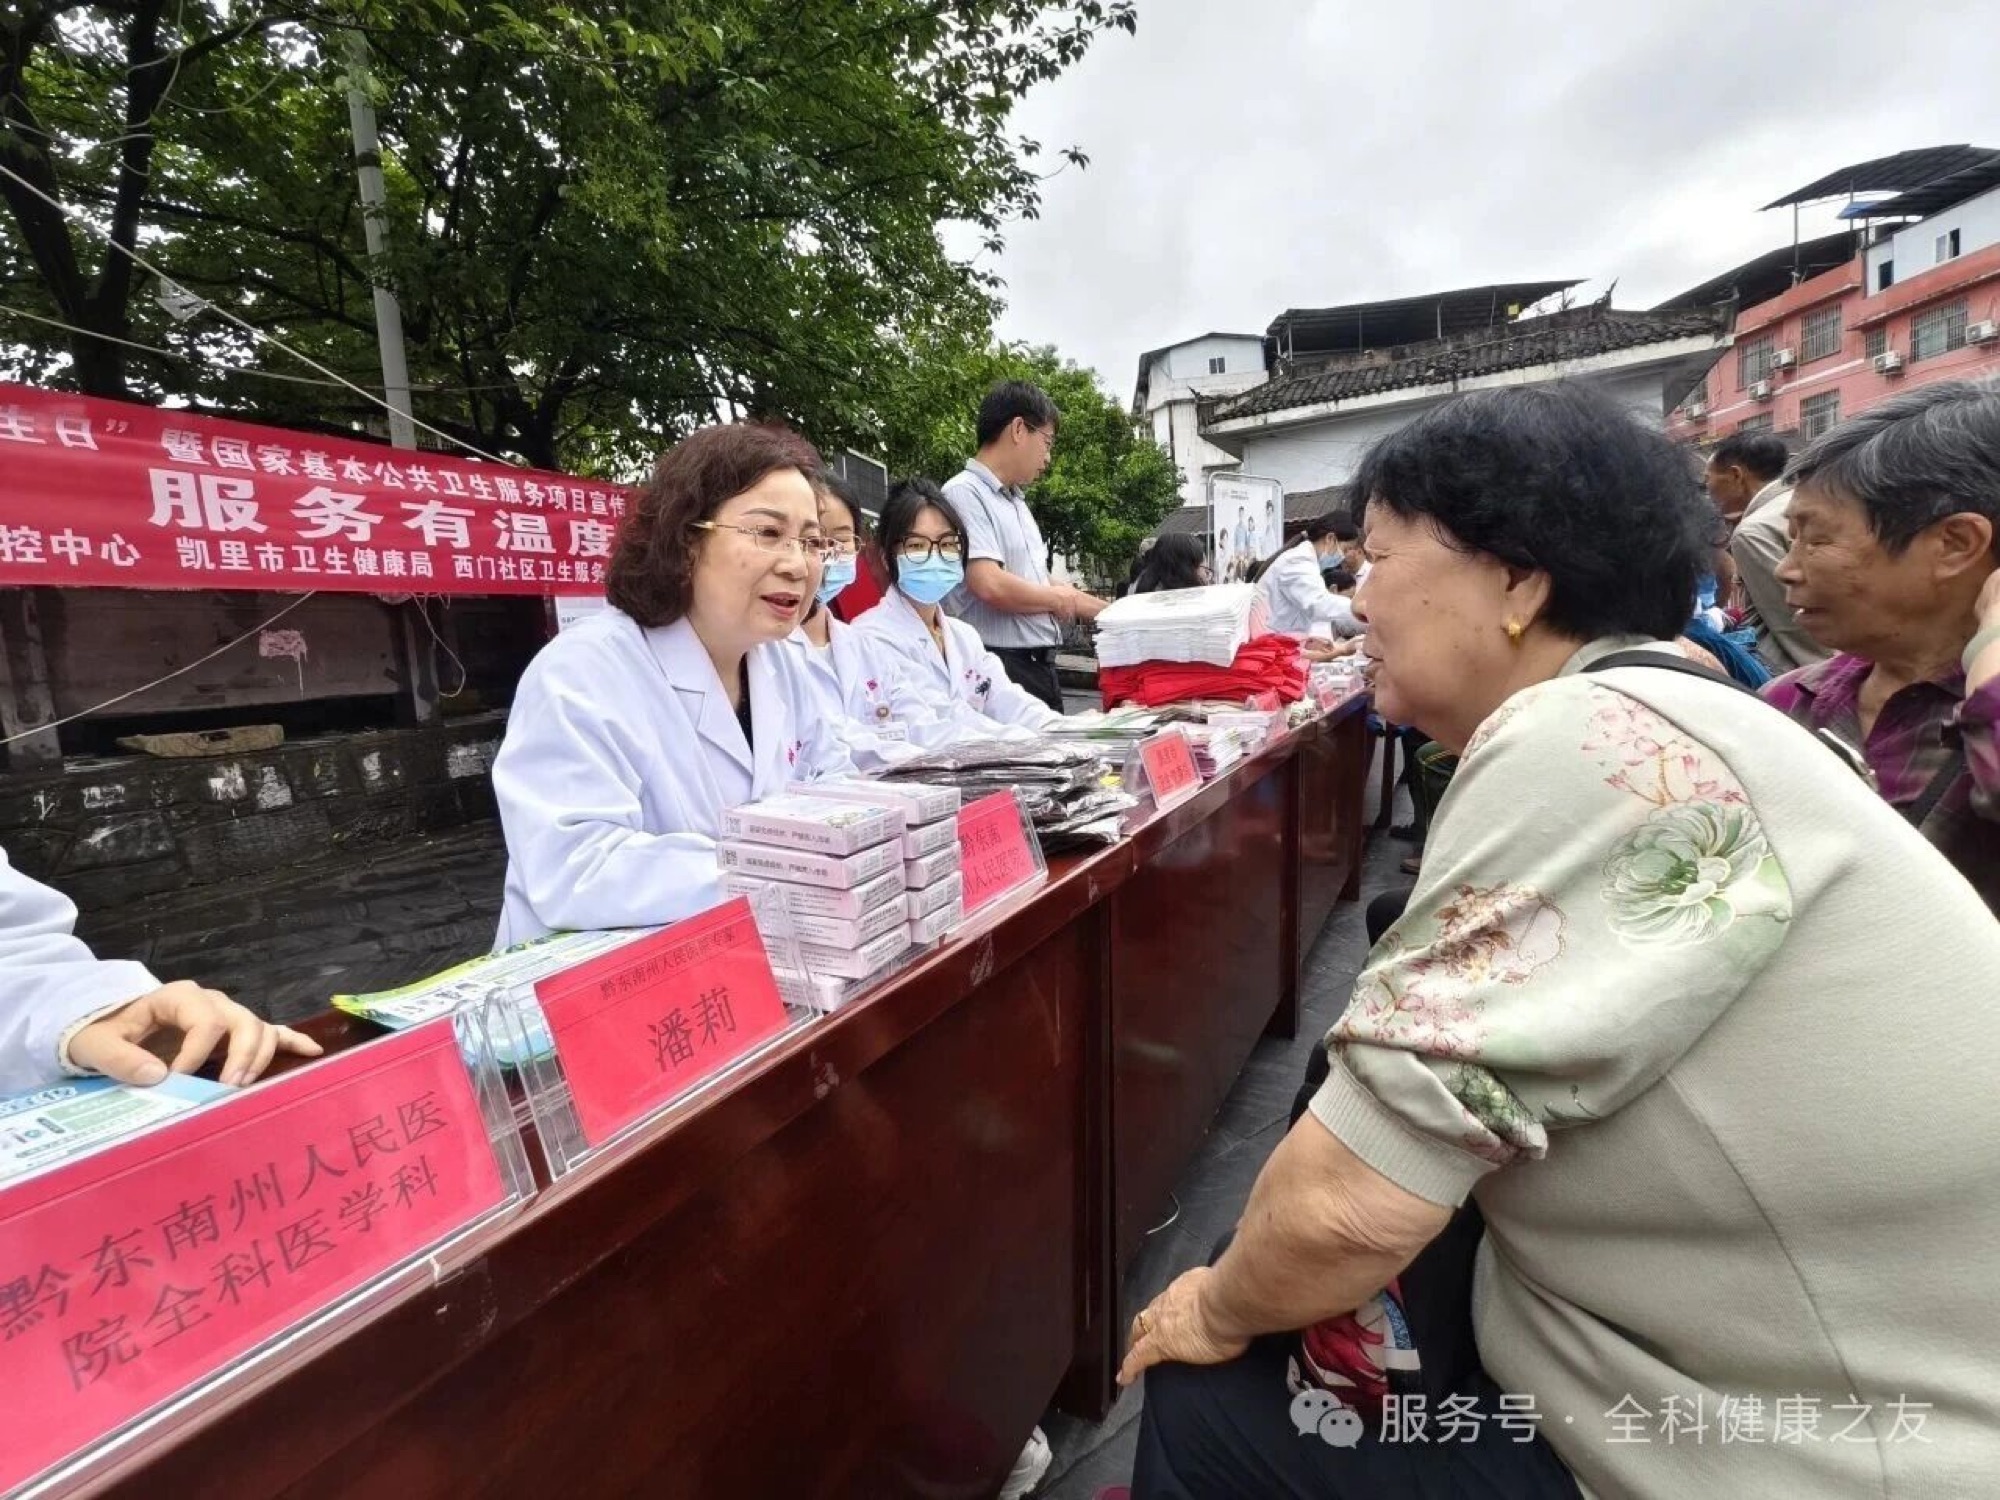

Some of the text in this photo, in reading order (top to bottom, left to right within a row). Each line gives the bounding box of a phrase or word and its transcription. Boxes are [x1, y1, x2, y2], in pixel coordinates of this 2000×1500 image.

[0, 524, 142, 568] 控中心
[175, 535, 433, 578] 凯里市卫生健康局
[148, 468, 615, 557] 服务有温度
[647, 986, 736, 1073] 潘莉
[0, 1090, 448, 1341] 黔东南州人民医
[61, 1154, 440, 1392] 院全科医学科
